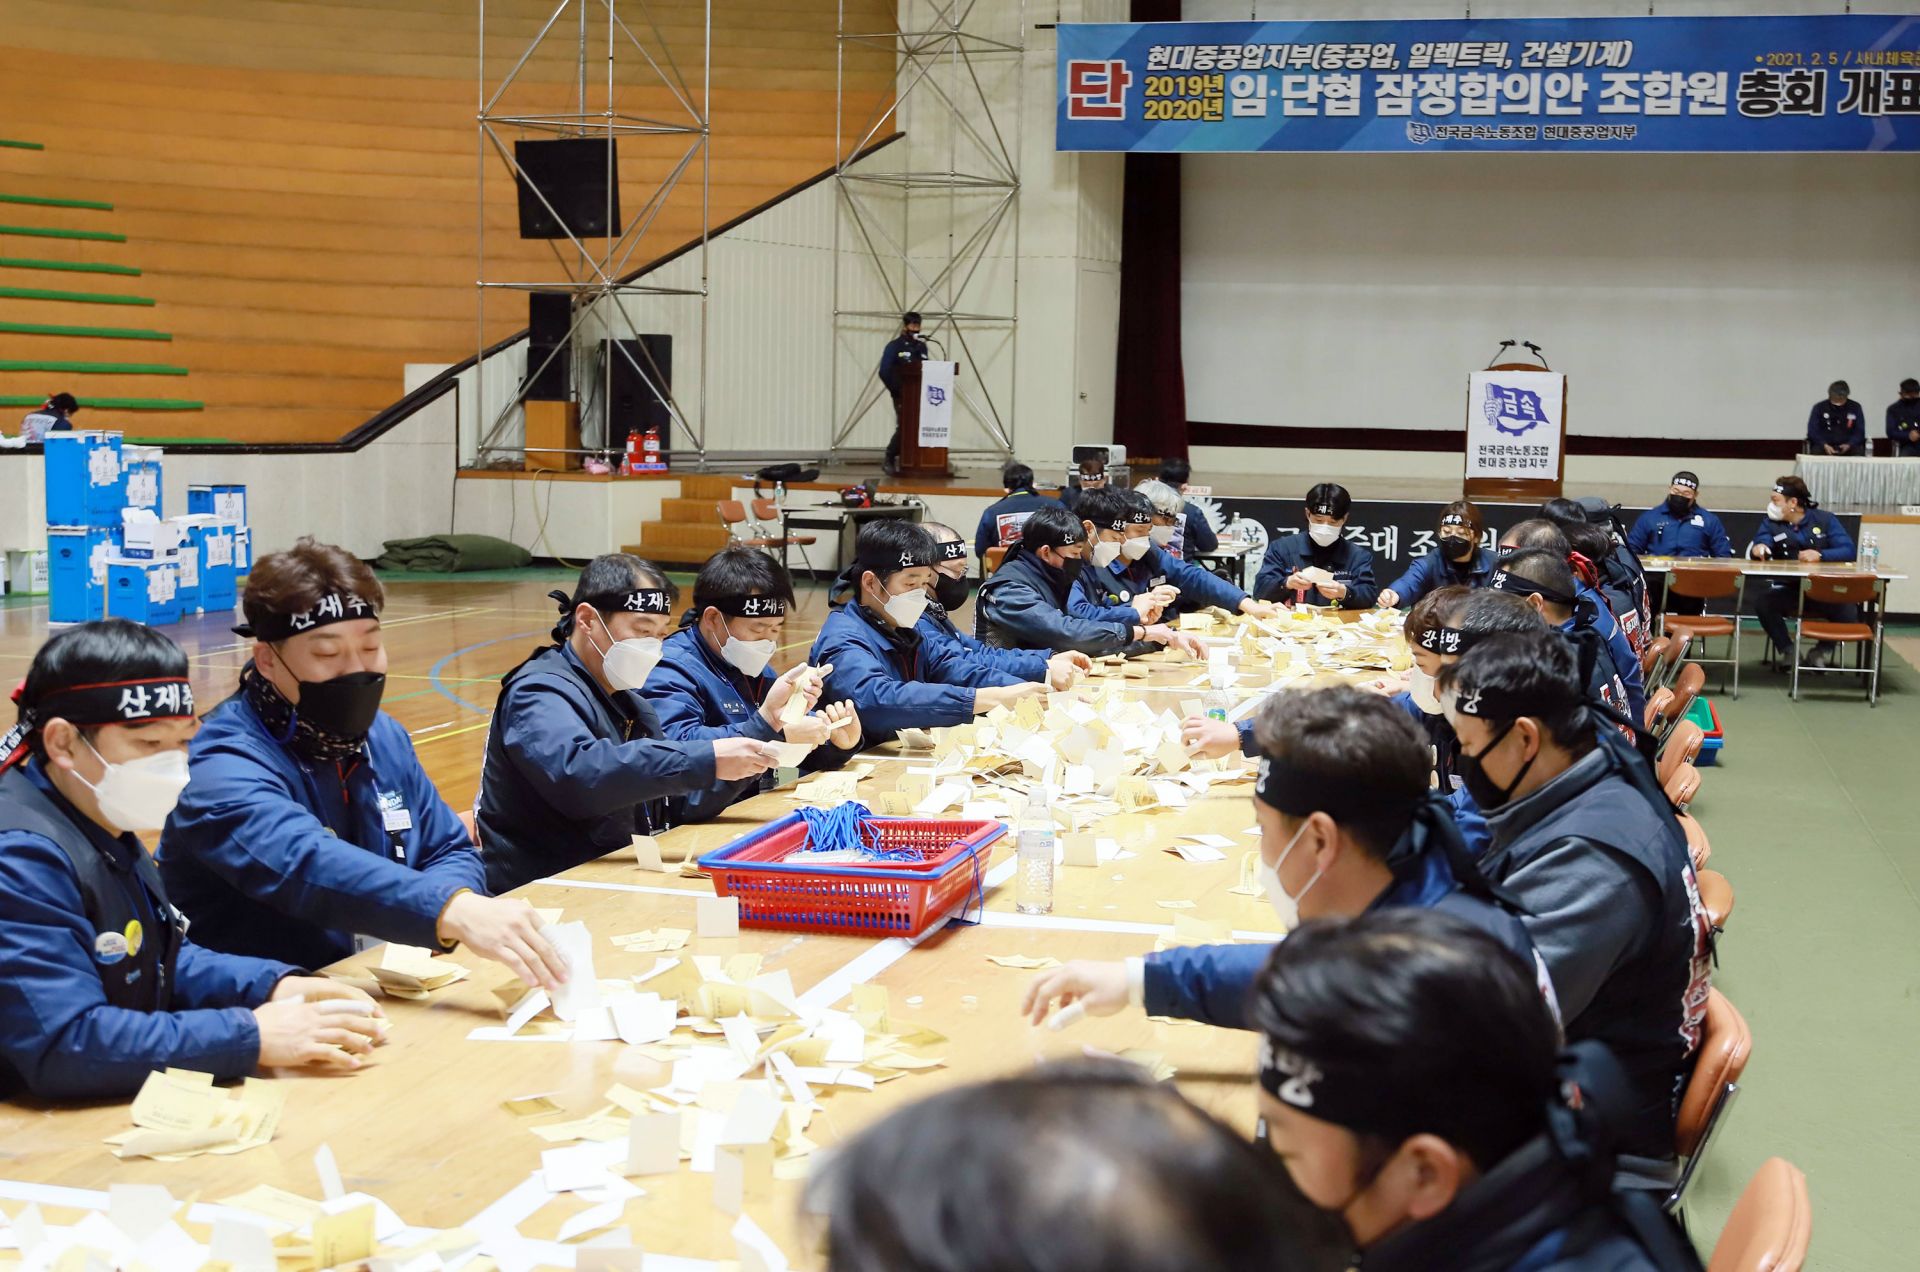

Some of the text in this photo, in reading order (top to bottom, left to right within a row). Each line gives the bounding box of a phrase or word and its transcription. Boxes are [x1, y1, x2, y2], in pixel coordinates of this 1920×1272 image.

[1146, 40, 1634, 71] 현대중공업지부(중공업, 일렉트릭, 건설기계)
[1766, 53, 1807, 66] 2021.
[1828, 53, 1838, 65] 5
[1067, 59, 1132, 120] 단
[1144, 74, 1225, 98] 2019년
[1230, 69, 1920, 117] 임·단협 잠정합의안 조합원 총회 개표
[1144, 99, 1225, 120] 2020년
[1435, 125, 1537, 140] 전국금속노동조합
[1543, 124, 1637, 140] 현대중공업지부
[1479, 445, 1549, 457] 전국금속노동조합
[1478, 457, 1548, 468] 현대중공업지부
